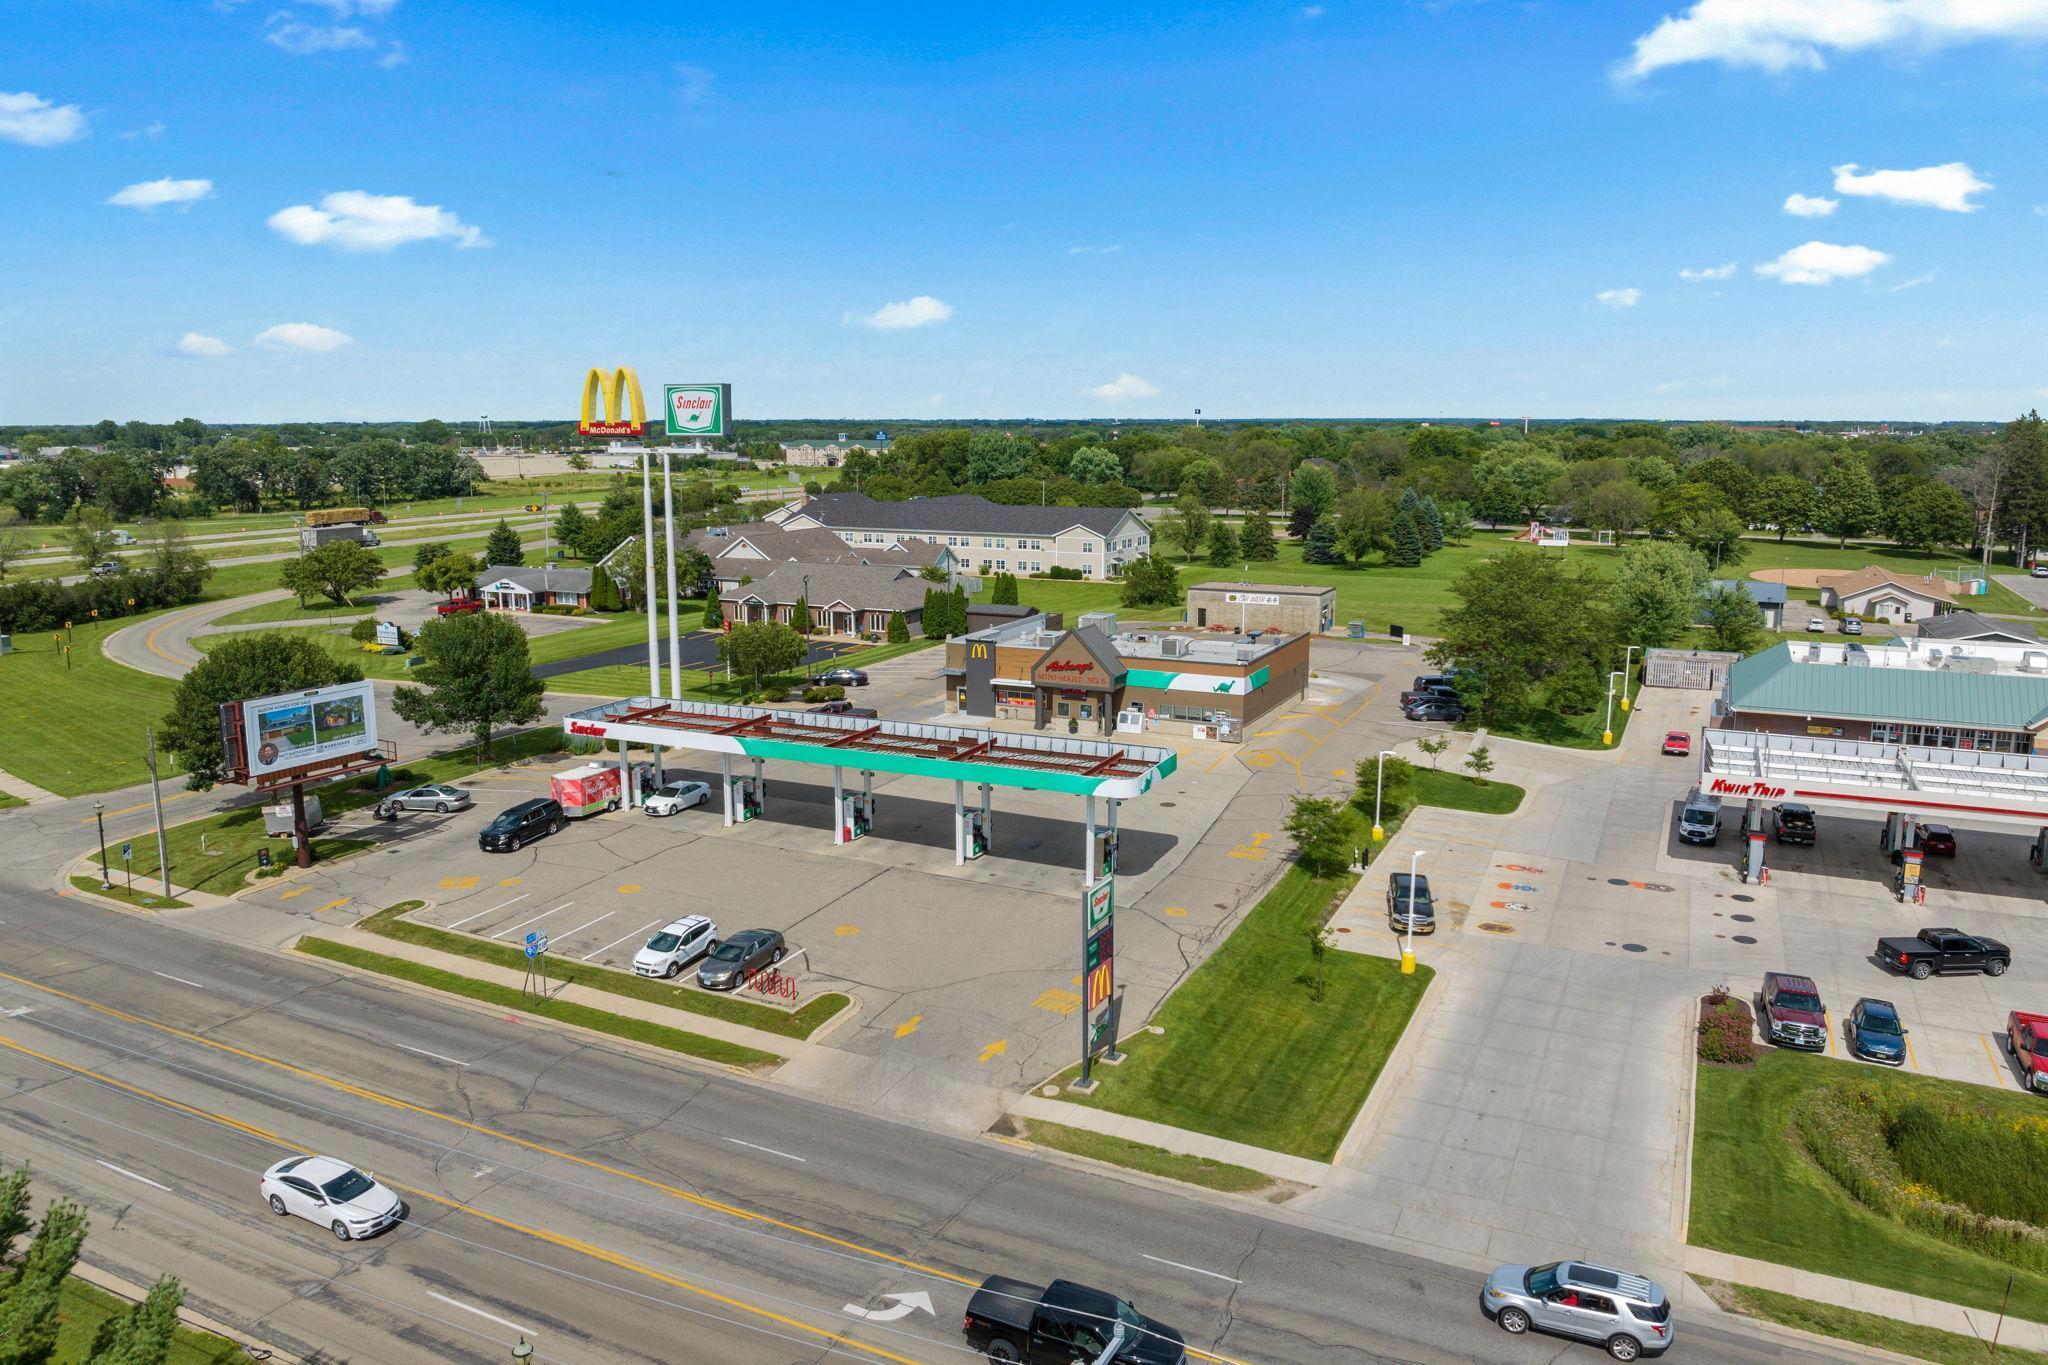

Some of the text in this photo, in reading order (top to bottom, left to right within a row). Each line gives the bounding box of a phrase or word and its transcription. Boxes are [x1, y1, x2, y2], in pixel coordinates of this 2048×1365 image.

[676, 396, 713, 410] Sinclair
[589, 426, 631, 434] McDonald's
[1037, 673, 1083, 684] MINI-MART
[570, 721, 607, 737] Sinclair
[1710, 779, 1785, 797] KWIK TRIP
